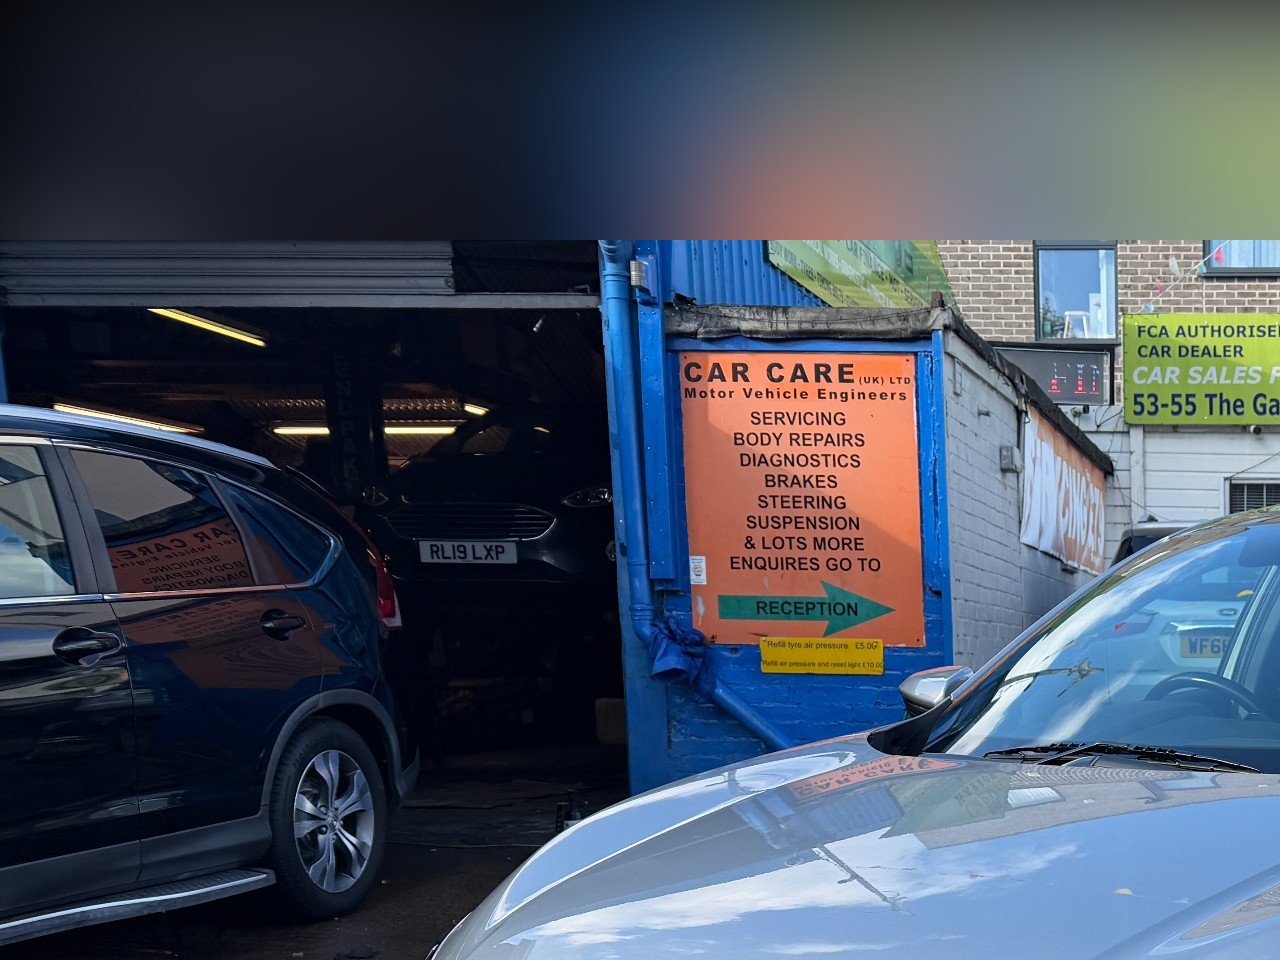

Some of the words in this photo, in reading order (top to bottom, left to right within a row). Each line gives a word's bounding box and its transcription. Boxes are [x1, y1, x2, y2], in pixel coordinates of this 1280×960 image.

[1138, 325, 1169, 339] FCA
[1138, 344, 1176, 359] CAR
[1178, 344, 1244, 359] DEALER
[684, 362, 750, 384] CAR
[767, 362, 855, 384] CARE
[858, 376, 884, 385] (UK)
[890, 376, 911, 385] LTD
[1132, 366, 1179, 385] CAR
[1187, 365, 1263, 385] SALES
[684, 387, 734, 399] Motor
[745, 388, 808, 399] Vehicle
[817, 388, 907, 402] Engineers
[1133, 393, 1197, 417] 53-55
[1205, 393, 1245, 416] The
[750, 411, 846, 426] SERVICING
[733, 432, 783, 447] BODY
[789, 433, 865, 447] REPAIRS
[740, 453, 861, 468] DIAGNOSTICS
[765, 474, 838, 489] BRAKES
[758, 495, 847, 510] STEERING
[746, 515, 860, 531] SUSPENSION
[744, 536, 756, 550] &
[762, 536, 807, 551] LOTS
[813, 536, 864, 551] MORE
[430, 544, 467, 560] RL19
[472, 544, 505, 560] LXP
[730, 556, 820, 572] ENQUIRES
[826, 557, 852, 572] GO
[857, 557, 881, 573] TO
[756, 600, 859, 617] RECEPTION
[767, 641, 786, 649] Refill
[787, 641, 802, 650] tyre
[804, 641, 814, 649] air
[815, 642, 849, 651] pressure
[788, 661, 816, 669] pressure
